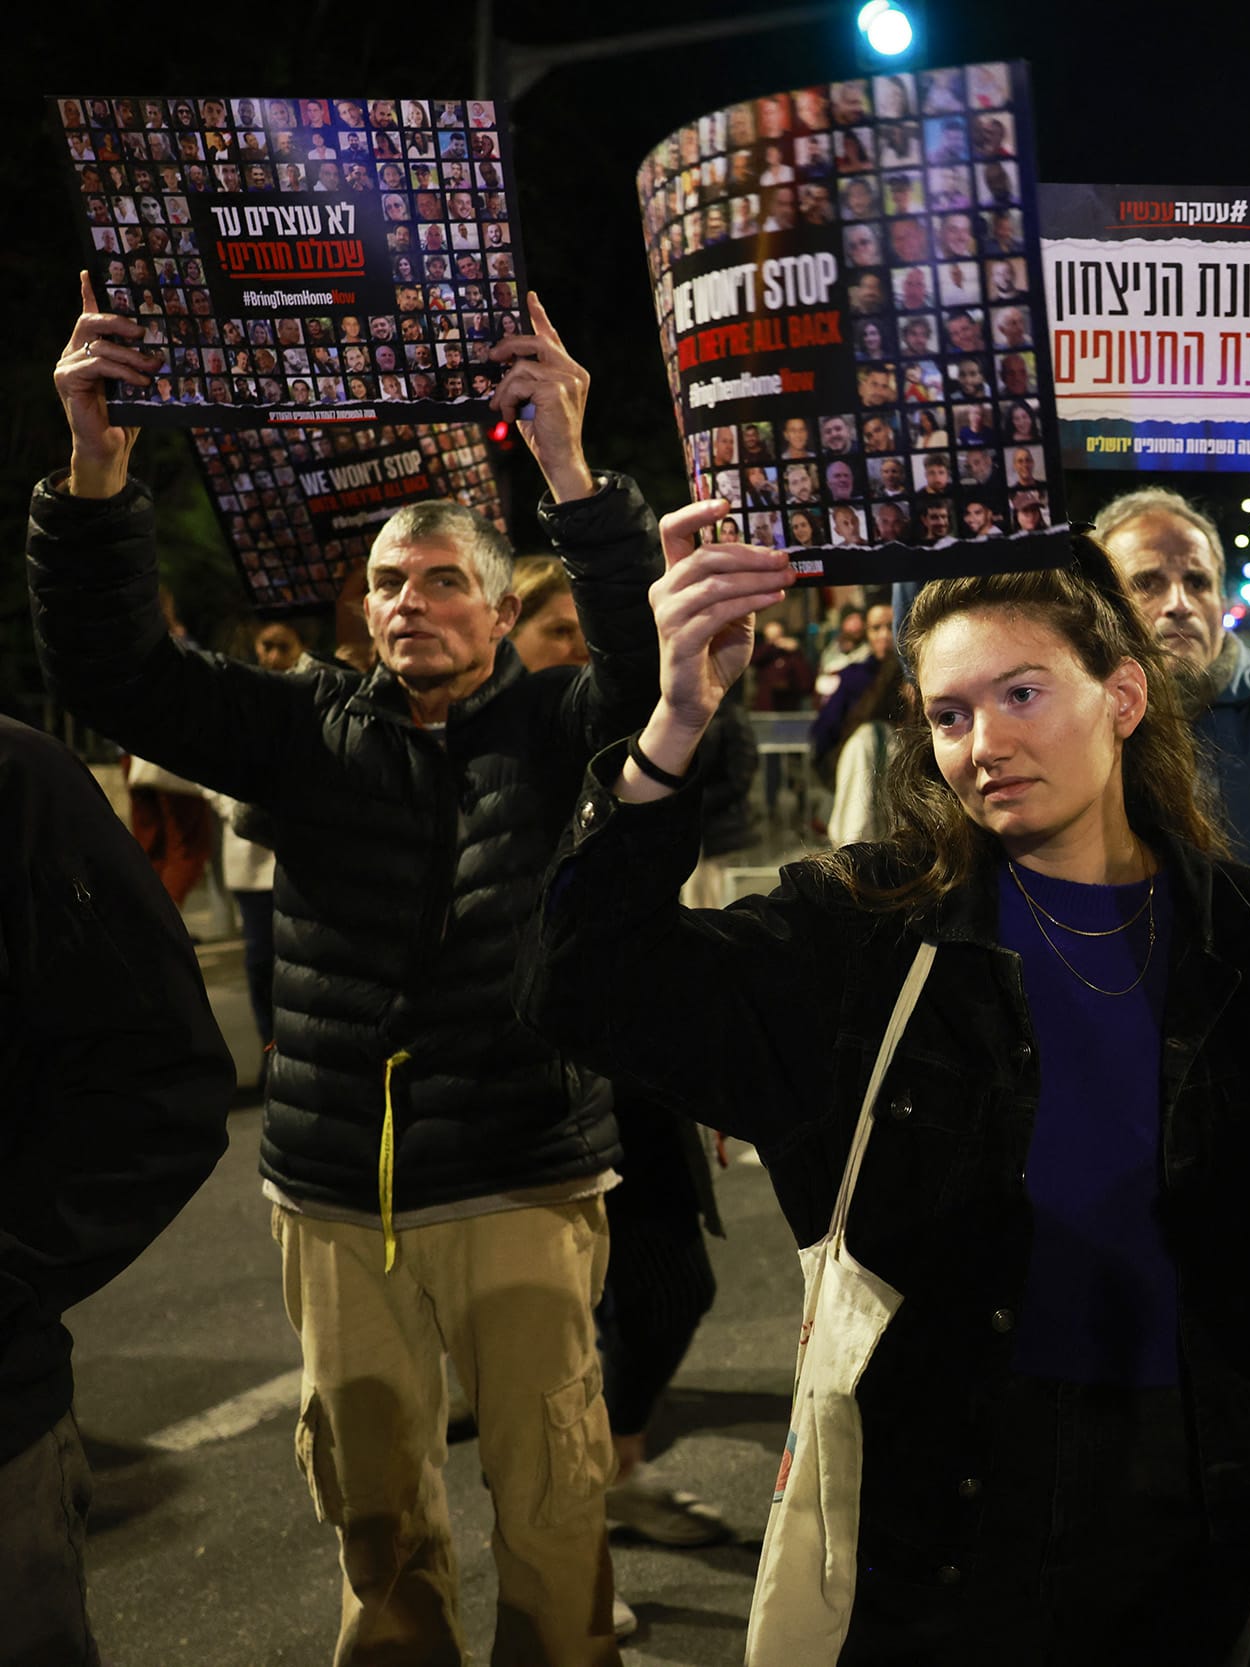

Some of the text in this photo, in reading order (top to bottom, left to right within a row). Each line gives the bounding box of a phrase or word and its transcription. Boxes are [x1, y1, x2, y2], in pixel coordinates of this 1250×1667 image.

[211, 201, 355, 237] לא עוצרים עד
[1119, 199, 1248, 226] #עסקהעכשיו
[216, 238, 365, 271] שכולם חוזרים!
[243, 289, 355, 309] #BringThemHomeNow
[762, 252, 837, 310] STOP
[1055, 260, 1183, 322] הניצחון
[753, 316, 786, 352] ALL
[788, 310, 843, 348] BACK
[1054, 330, 1205, 385] החטופים
[300, 449, 422, 496] WE WON'T STOP
